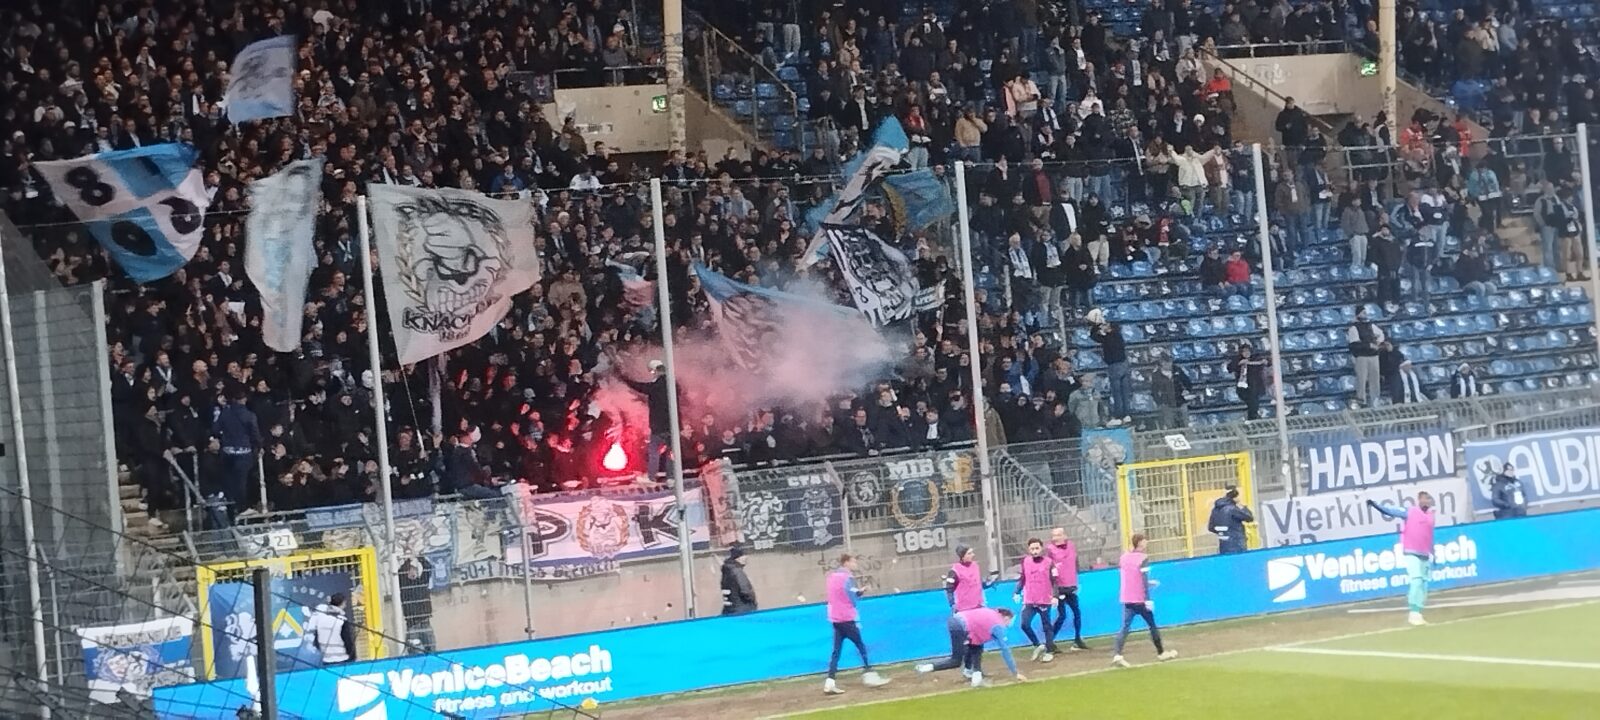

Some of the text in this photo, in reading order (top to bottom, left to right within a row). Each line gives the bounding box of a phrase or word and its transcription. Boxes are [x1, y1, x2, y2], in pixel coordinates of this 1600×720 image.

[1309, 432, 1455, 490] HADERN
[634, 500, 697, 549] K
[274, 535, 291, 546] 27
[894, 528, 947, 553] 1860
[1340, 577, 1388, 594] fitness
[387, 644, 613, 700] VeniceBeach
[500, 686, 536, 705] and
[539, 677, 613, 700] workout
